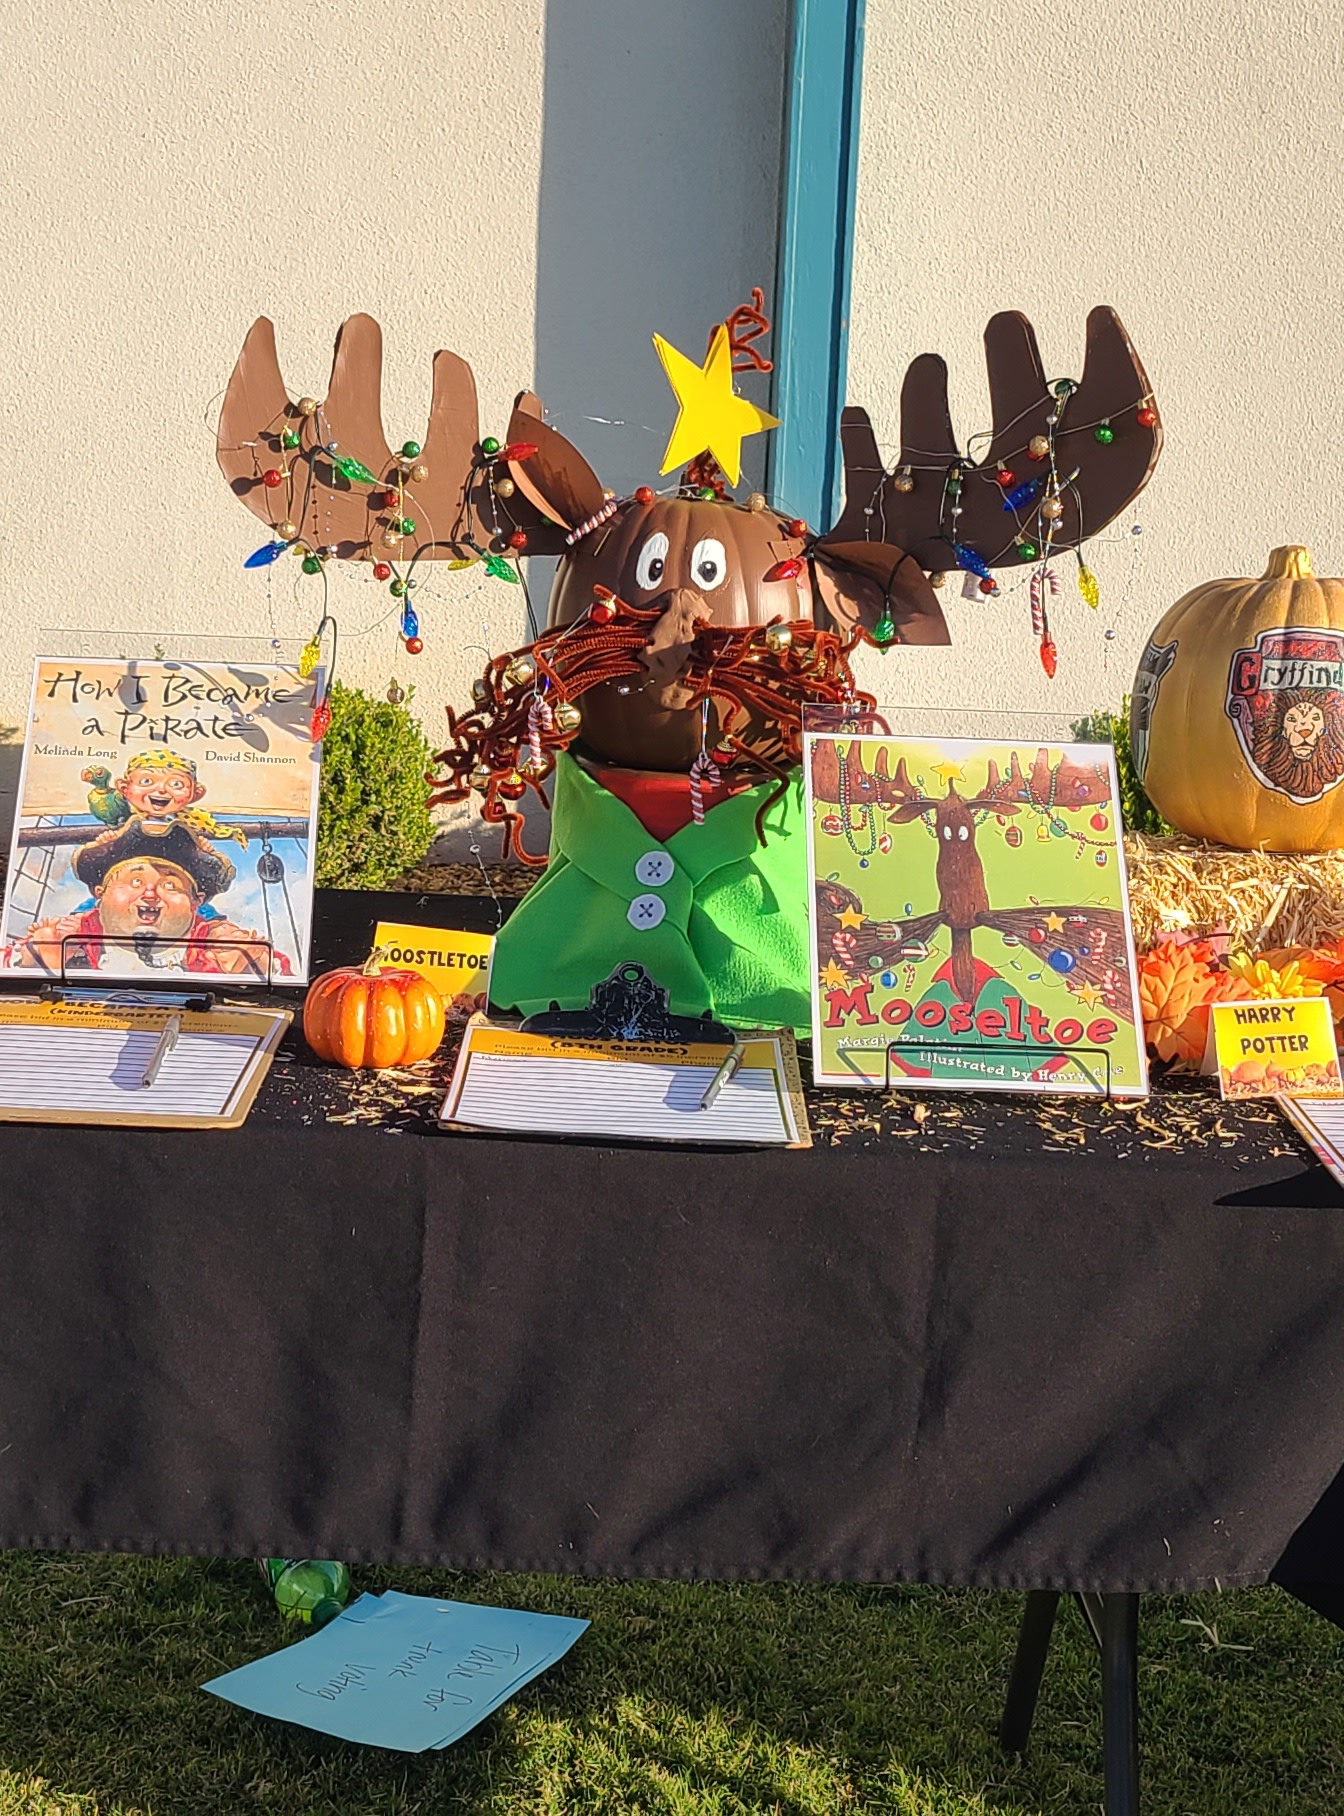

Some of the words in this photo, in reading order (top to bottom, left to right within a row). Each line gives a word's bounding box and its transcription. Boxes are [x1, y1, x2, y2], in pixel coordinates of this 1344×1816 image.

[44, 670, 121, 704] How
[132, 675, 151, 705] I
[162, 674, 304, 707] Became
[81, 714, 106, 737] a
[34, 744, 84, 757] Melinda
[87, 747, 118, 760] Long
[205, 750, 240, 763] David
[243, 752, 297, 765] Shannon
[824, 983, 1118, 1045] Mooseltoe
[1234, 1006, 1296, 1024] HARRY
[610, 1045, 688, 1056] GRADE)
[837, 1034, 894, 1048] Margie
[1240, 1034, 1309, 1055] POTTER
[919, 1051, 1005, 1076] Illustrated
[1011, 1067, 1033, 1081] by
[1038, 1069, 1086, 1082] Henry
[446, 1643, 521, 1680] Table
